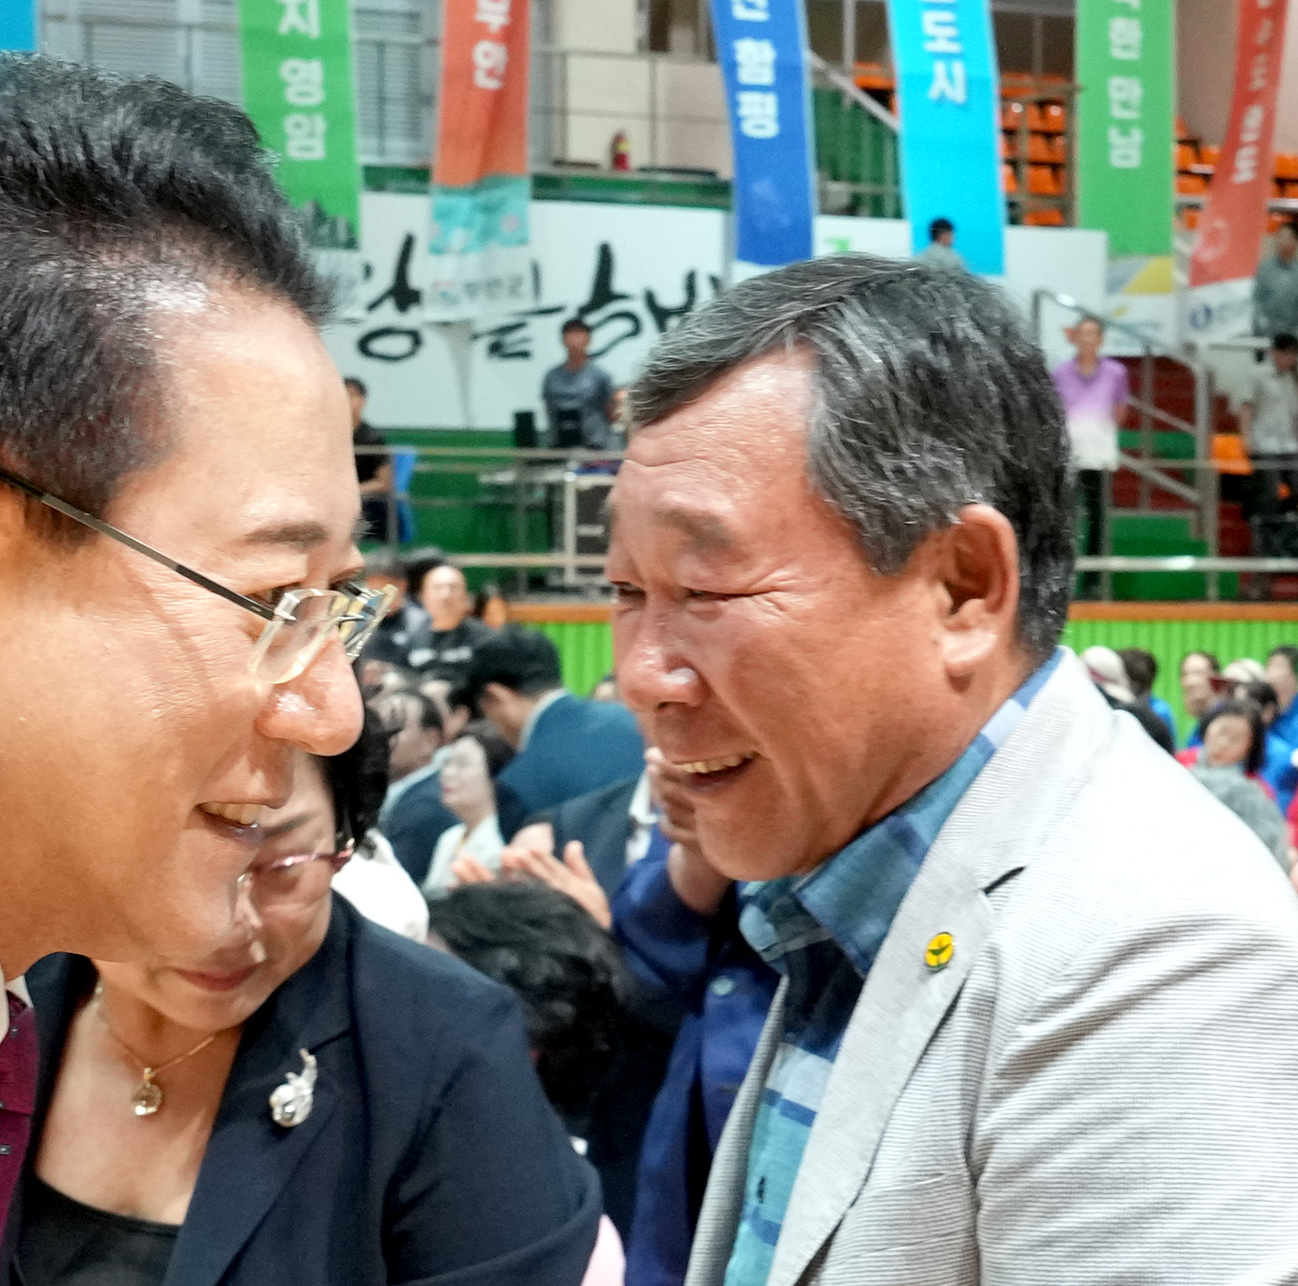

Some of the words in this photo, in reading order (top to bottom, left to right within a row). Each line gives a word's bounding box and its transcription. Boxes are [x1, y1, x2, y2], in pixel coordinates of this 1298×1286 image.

[733, 36, 781, 140] 함평
[921, 0, 967, 105] 도시
[279, 57, 327, 161] 영암
